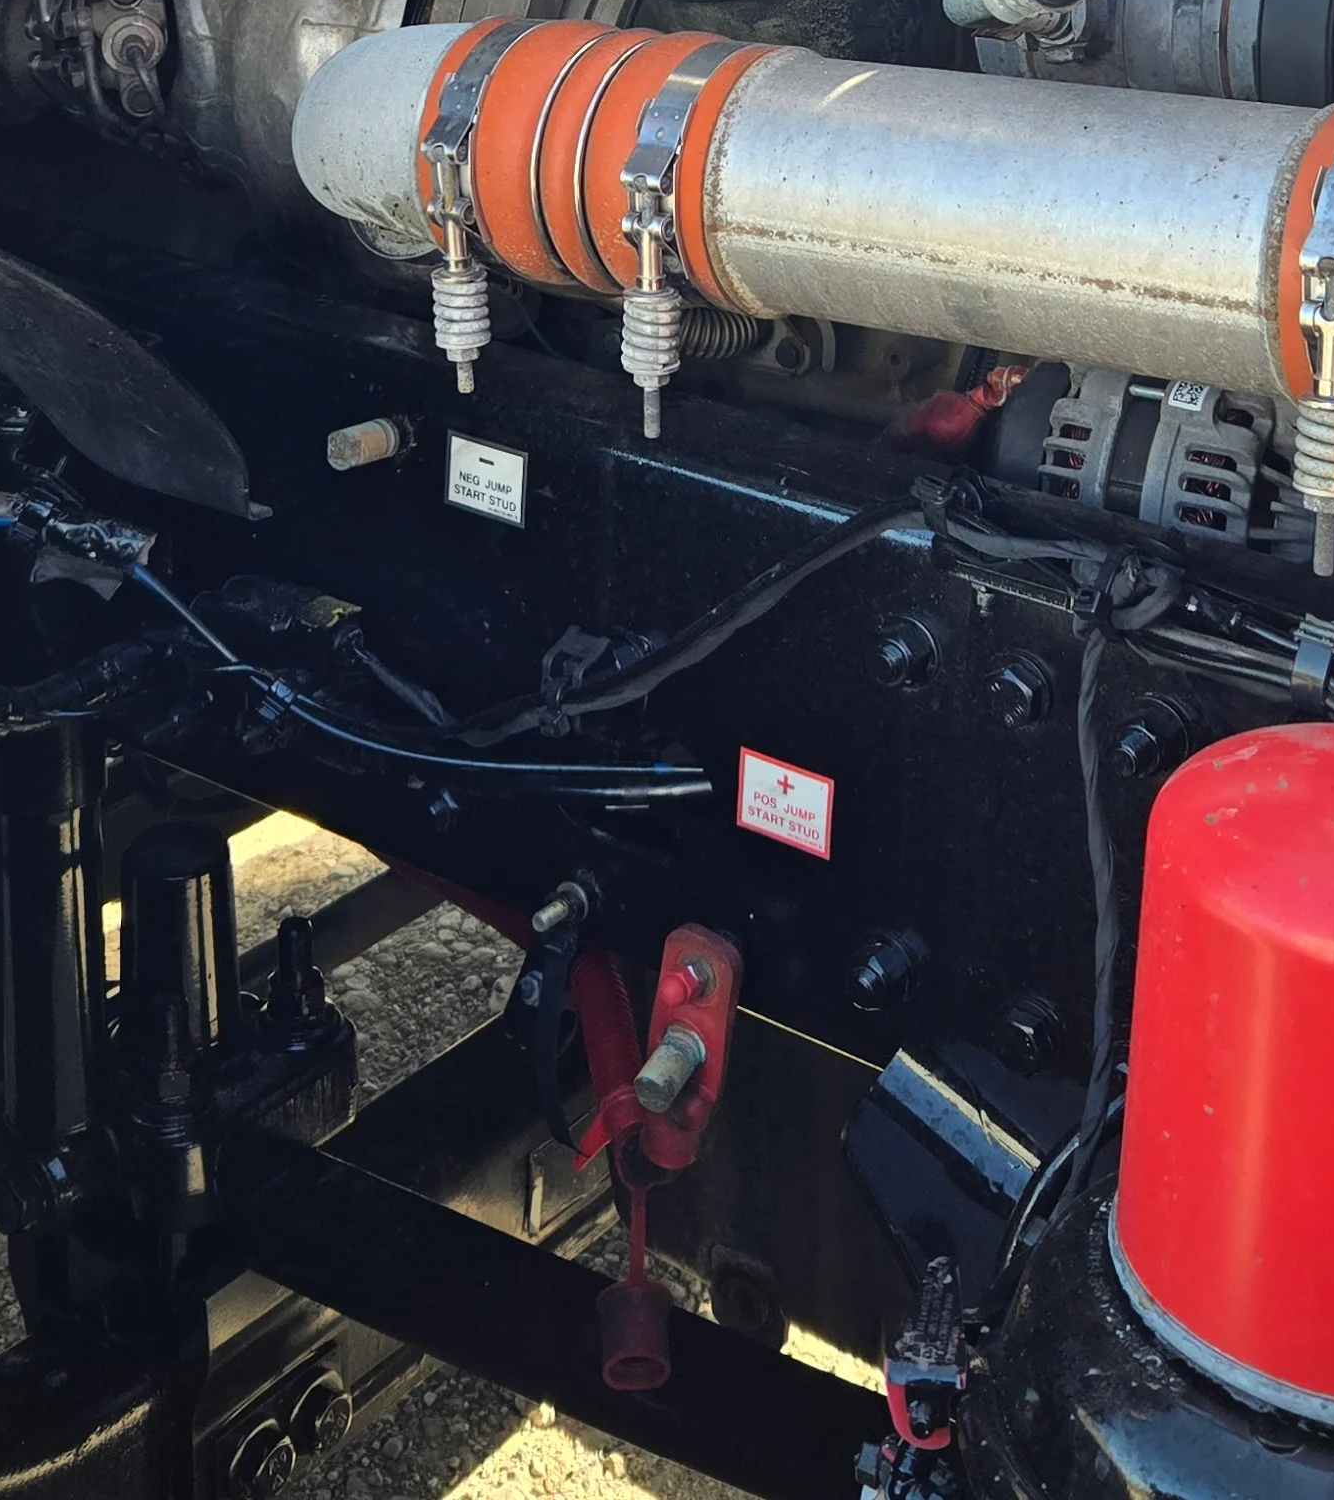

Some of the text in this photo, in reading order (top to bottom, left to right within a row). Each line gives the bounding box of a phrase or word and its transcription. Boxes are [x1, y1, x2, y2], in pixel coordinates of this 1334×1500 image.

[459, 470, 513, 495] NEG JUMP
[453, 483, 517, 512] START STUD
[753, 791, 816, 821] POS JUMP
[748, 805, 786, 828] START
[788, 820, 820, 841] STUD
